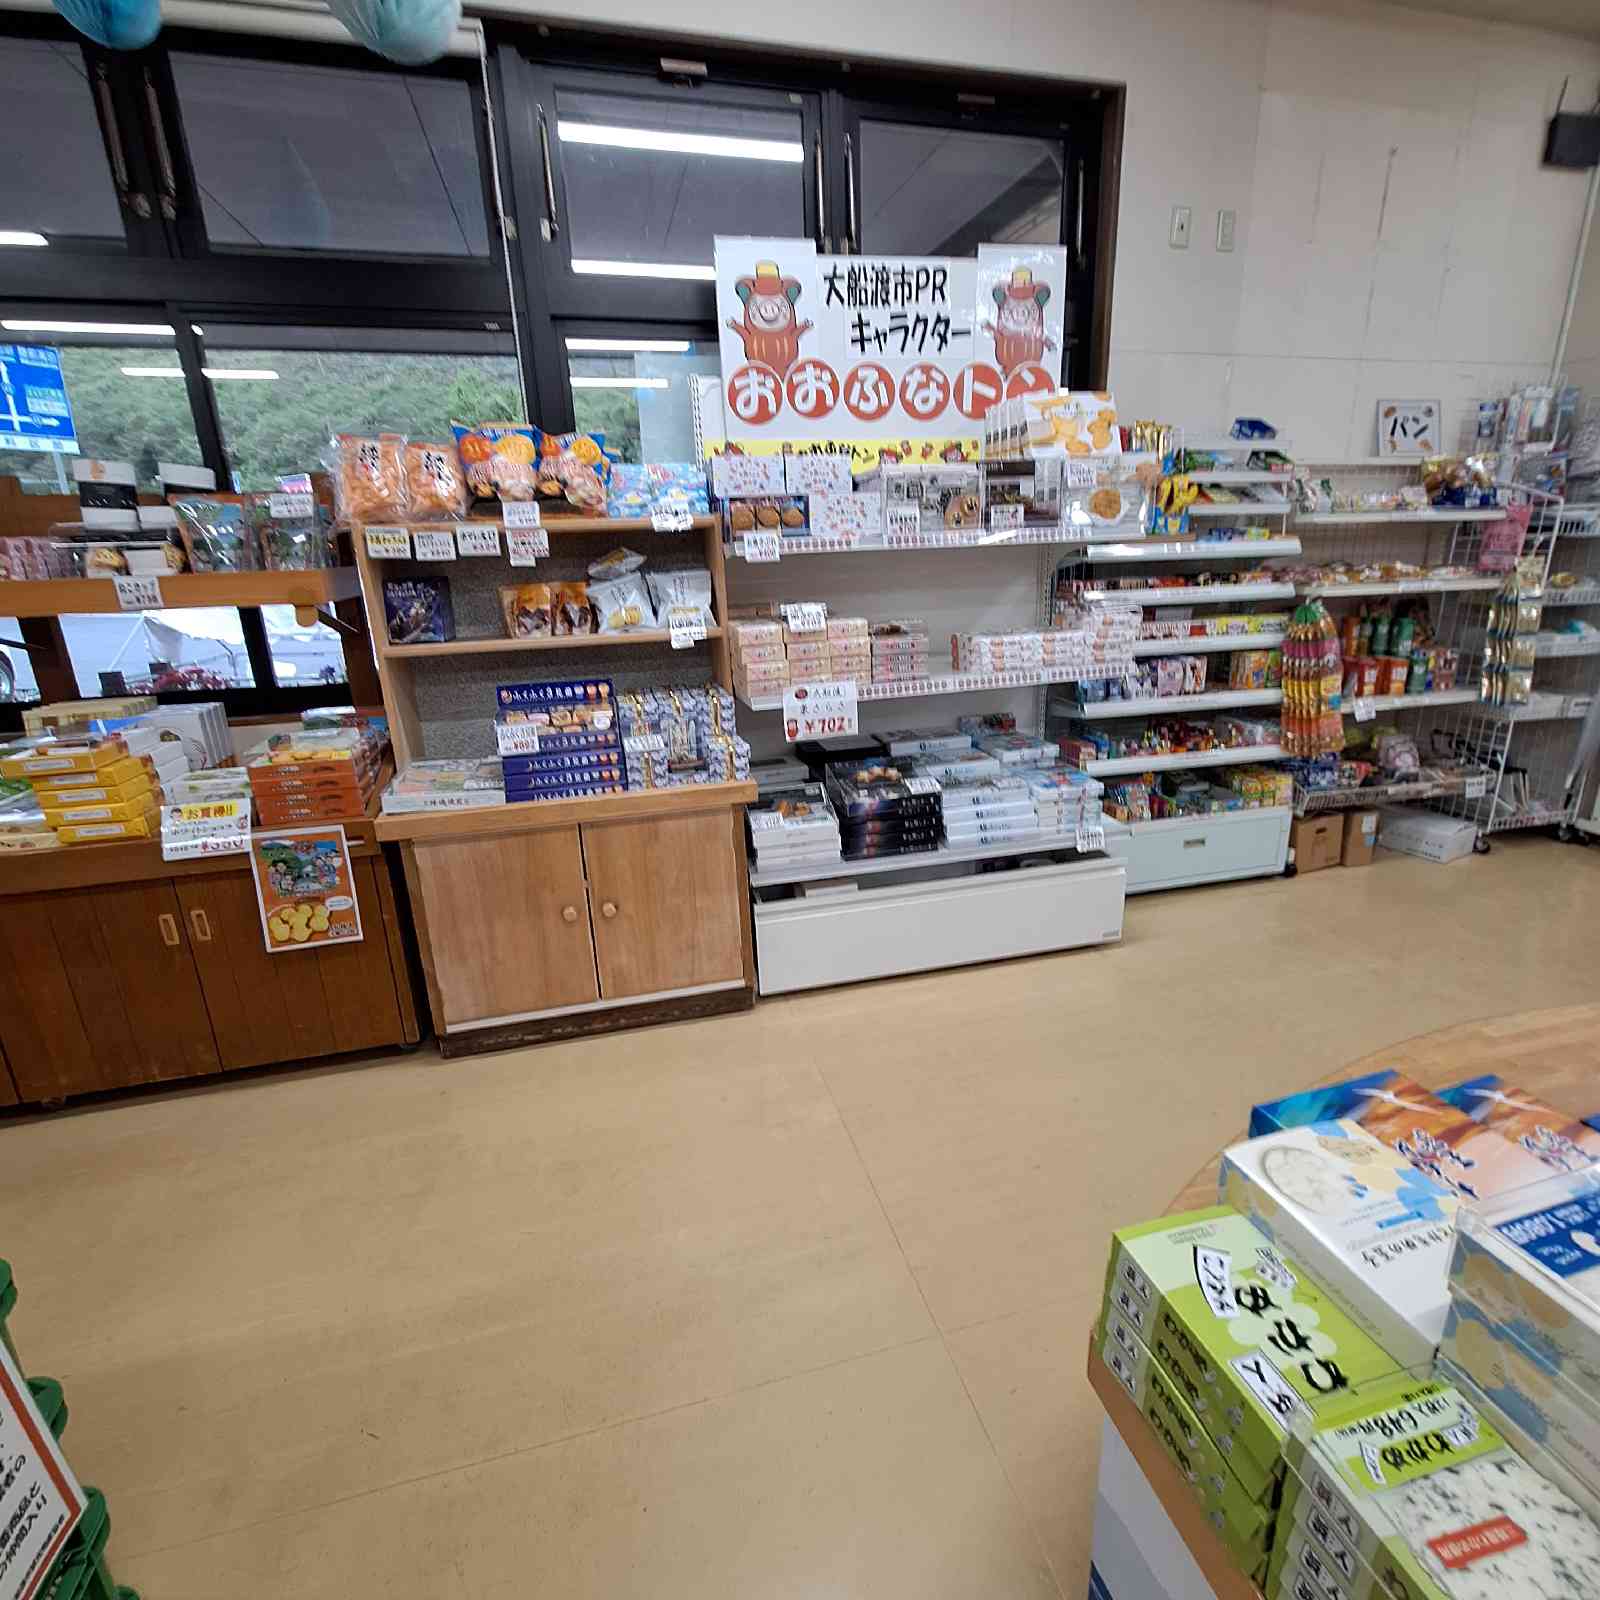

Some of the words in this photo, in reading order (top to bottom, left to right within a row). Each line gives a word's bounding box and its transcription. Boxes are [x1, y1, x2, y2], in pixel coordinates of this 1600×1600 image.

[824, 262, 948, 308] 大船渡市PR
[851, 312, 972, 354] キャラクター
[1390, 416, 1429, 439] パン
[1234, 1284, 1350, 1394] わかめ
